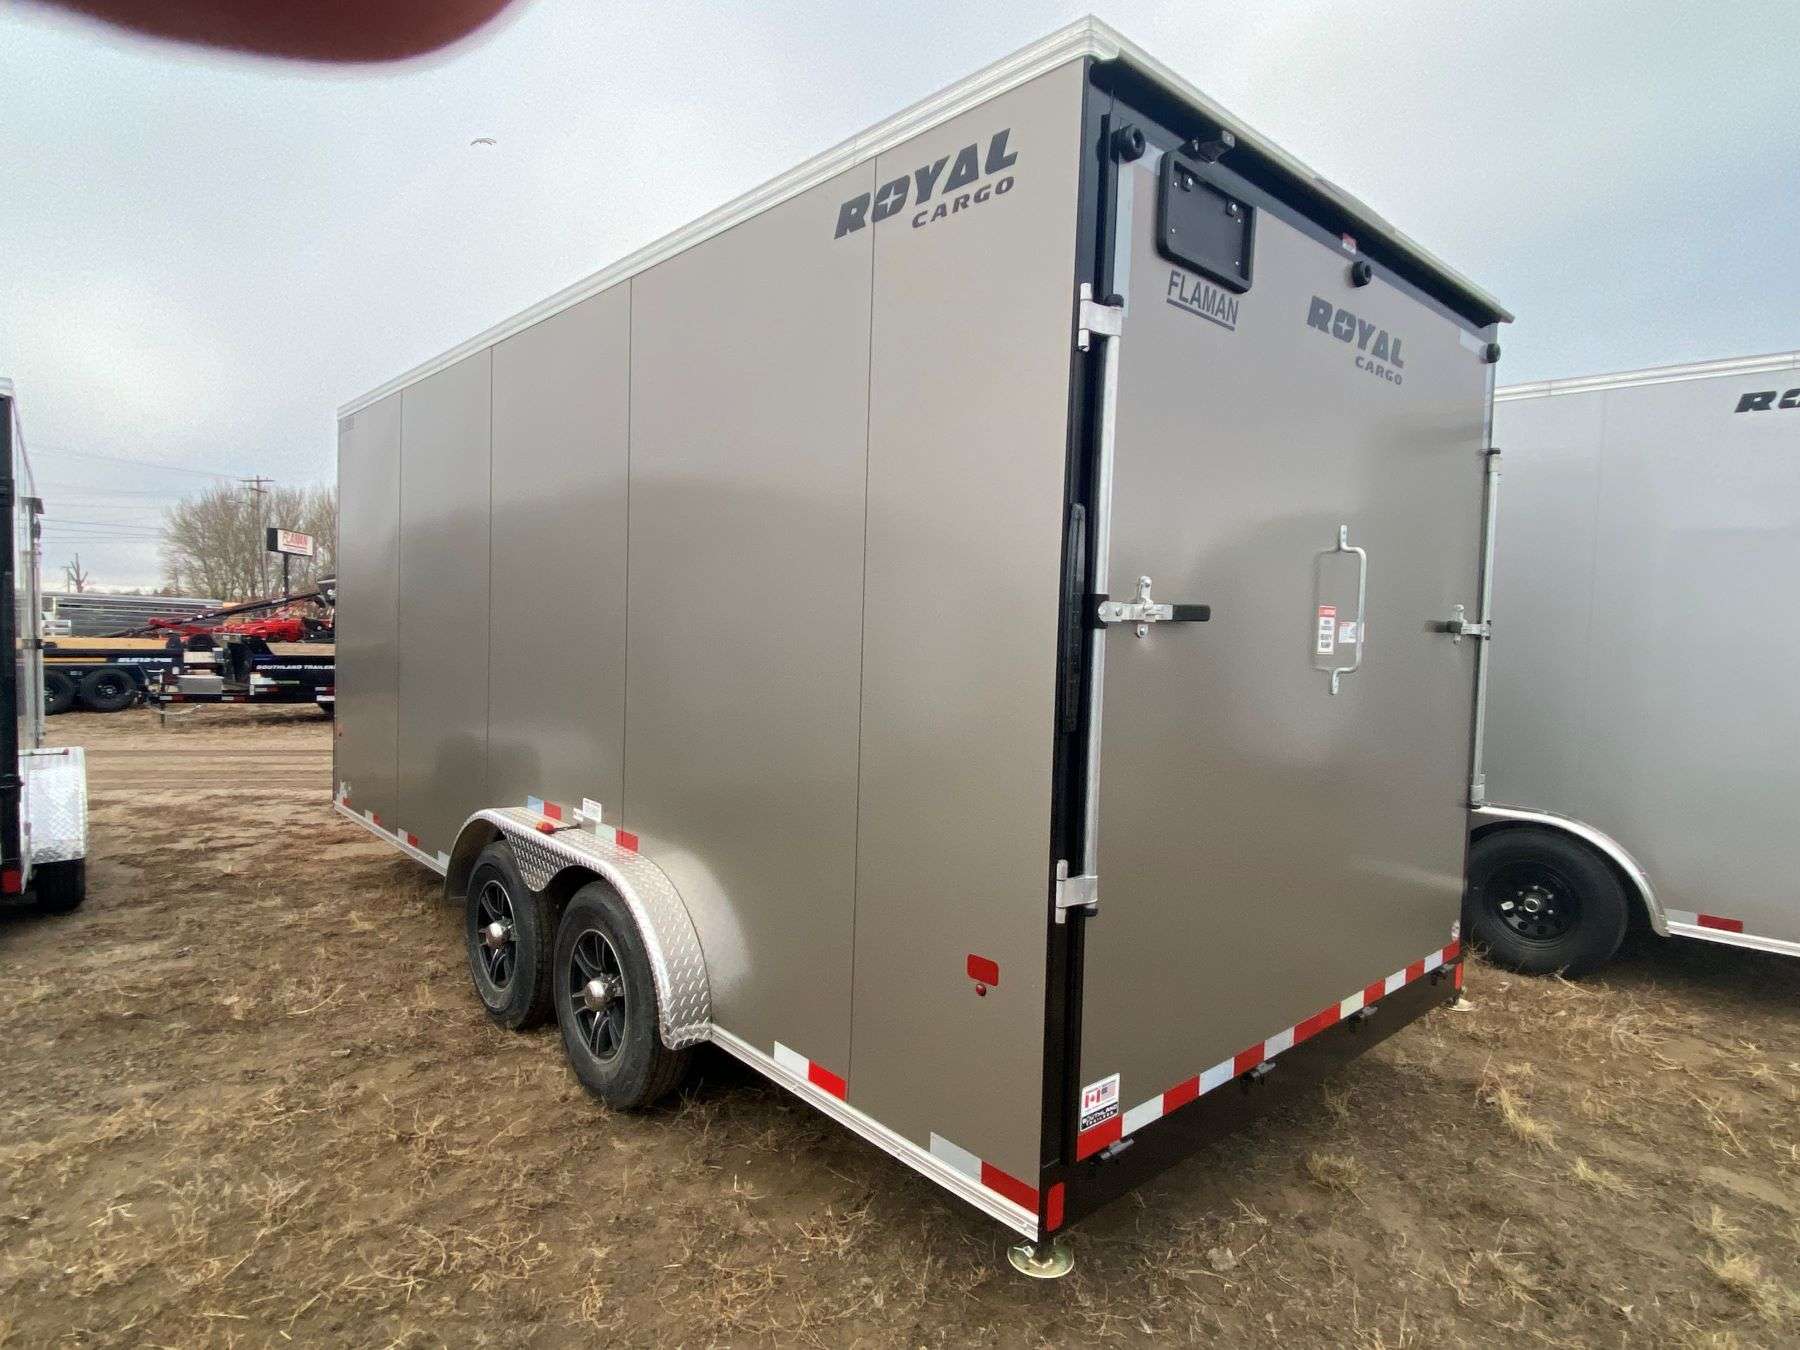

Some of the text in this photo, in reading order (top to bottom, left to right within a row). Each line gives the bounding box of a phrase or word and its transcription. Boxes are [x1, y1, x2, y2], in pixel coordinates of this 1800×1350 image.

[834, 127, 1018, 240] ROYAL
[912, 176, 1015, 229] CARGO
[1167, 270, 1240, 325] FLAMAN
[1306, 295, 1405, 369] ROYAL
[1354, 355, 1403, 386] CARGO
